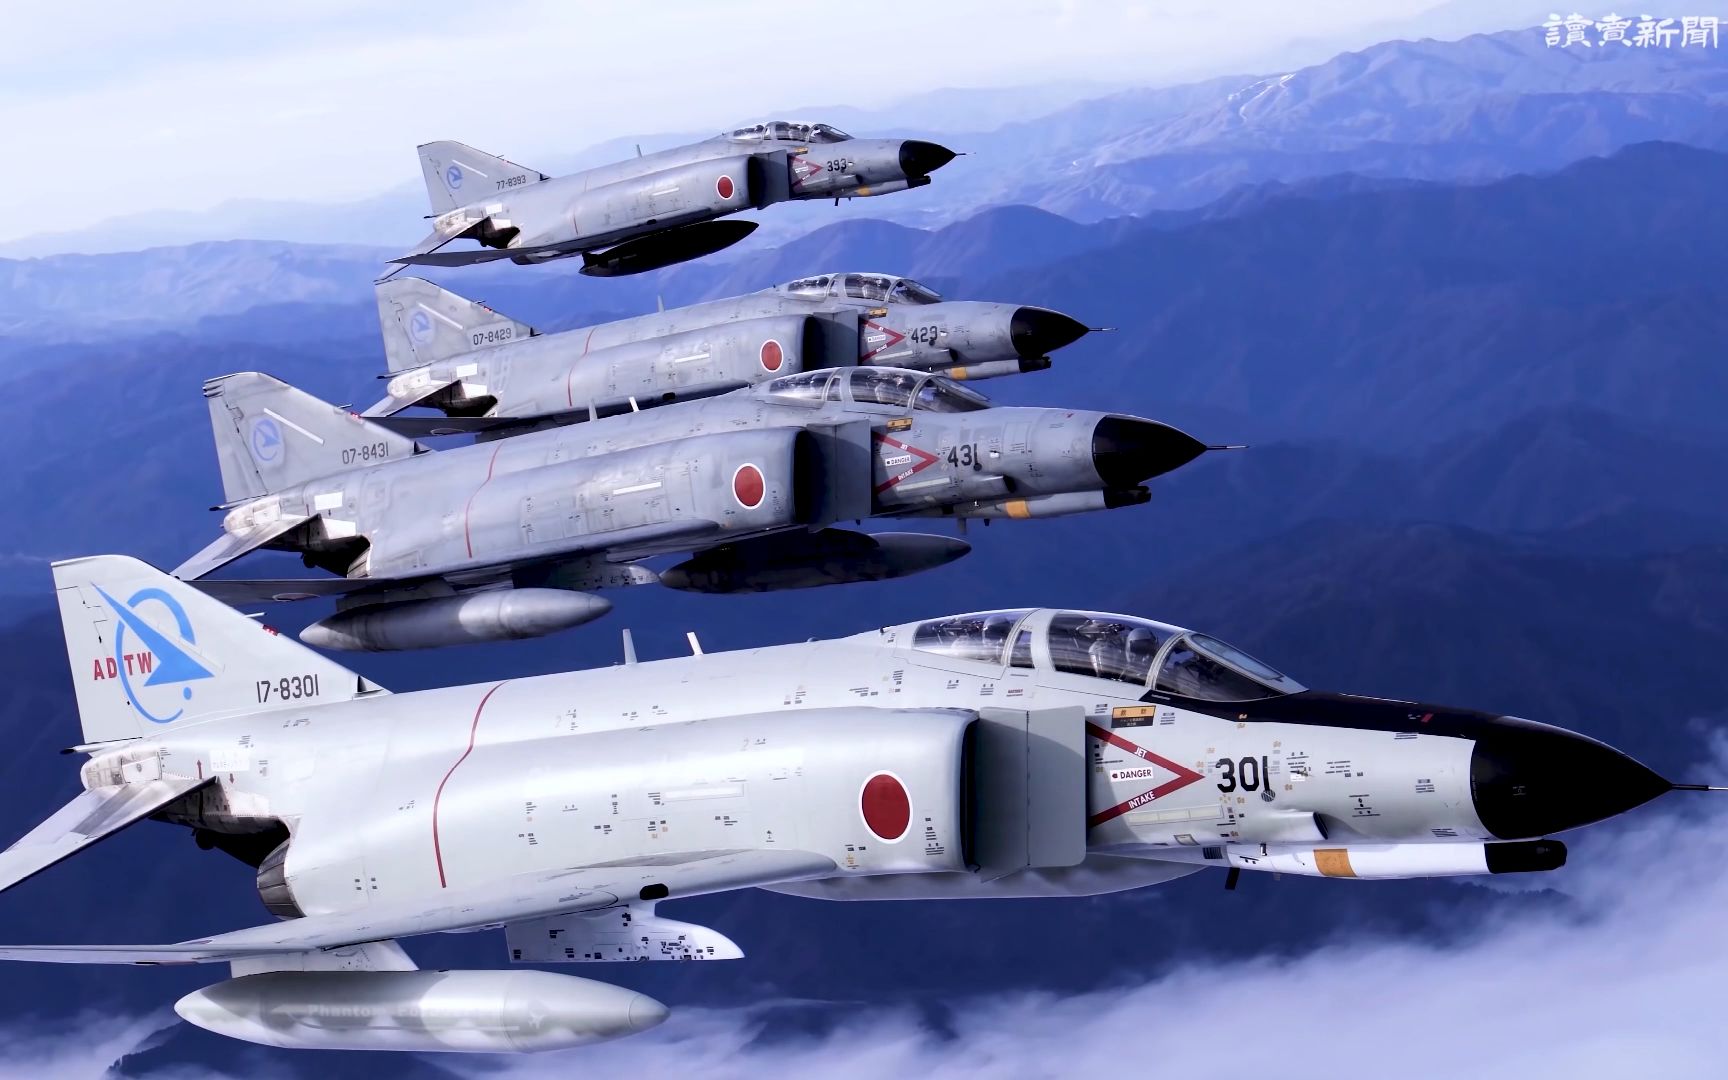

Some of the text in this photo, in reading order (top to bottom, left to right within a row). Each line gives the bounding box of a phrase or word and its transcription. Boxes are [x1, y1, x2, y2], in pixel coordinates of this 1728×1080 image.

[827, 158, 847, 172] 393
[496, 174, 526, 190] 77-8393
[473, 327, 511, 345] 07-8429
[911, 325, 938, 343] 429
[342, 441, 389, 464] 07-8431
[890, 455, 911, 466] DANGER
[947, 442, 979, 468] 431
[93, 651, 153, 681] ADTW
[256, 673, 320, 704] 17-8301
[1134, 746, 1148, 759] JET
[1119, 769, 1152, 780] DANGER
[1216, 755, 1270, 793] 301
[1127, 790, 1156, 809] INTAKE
